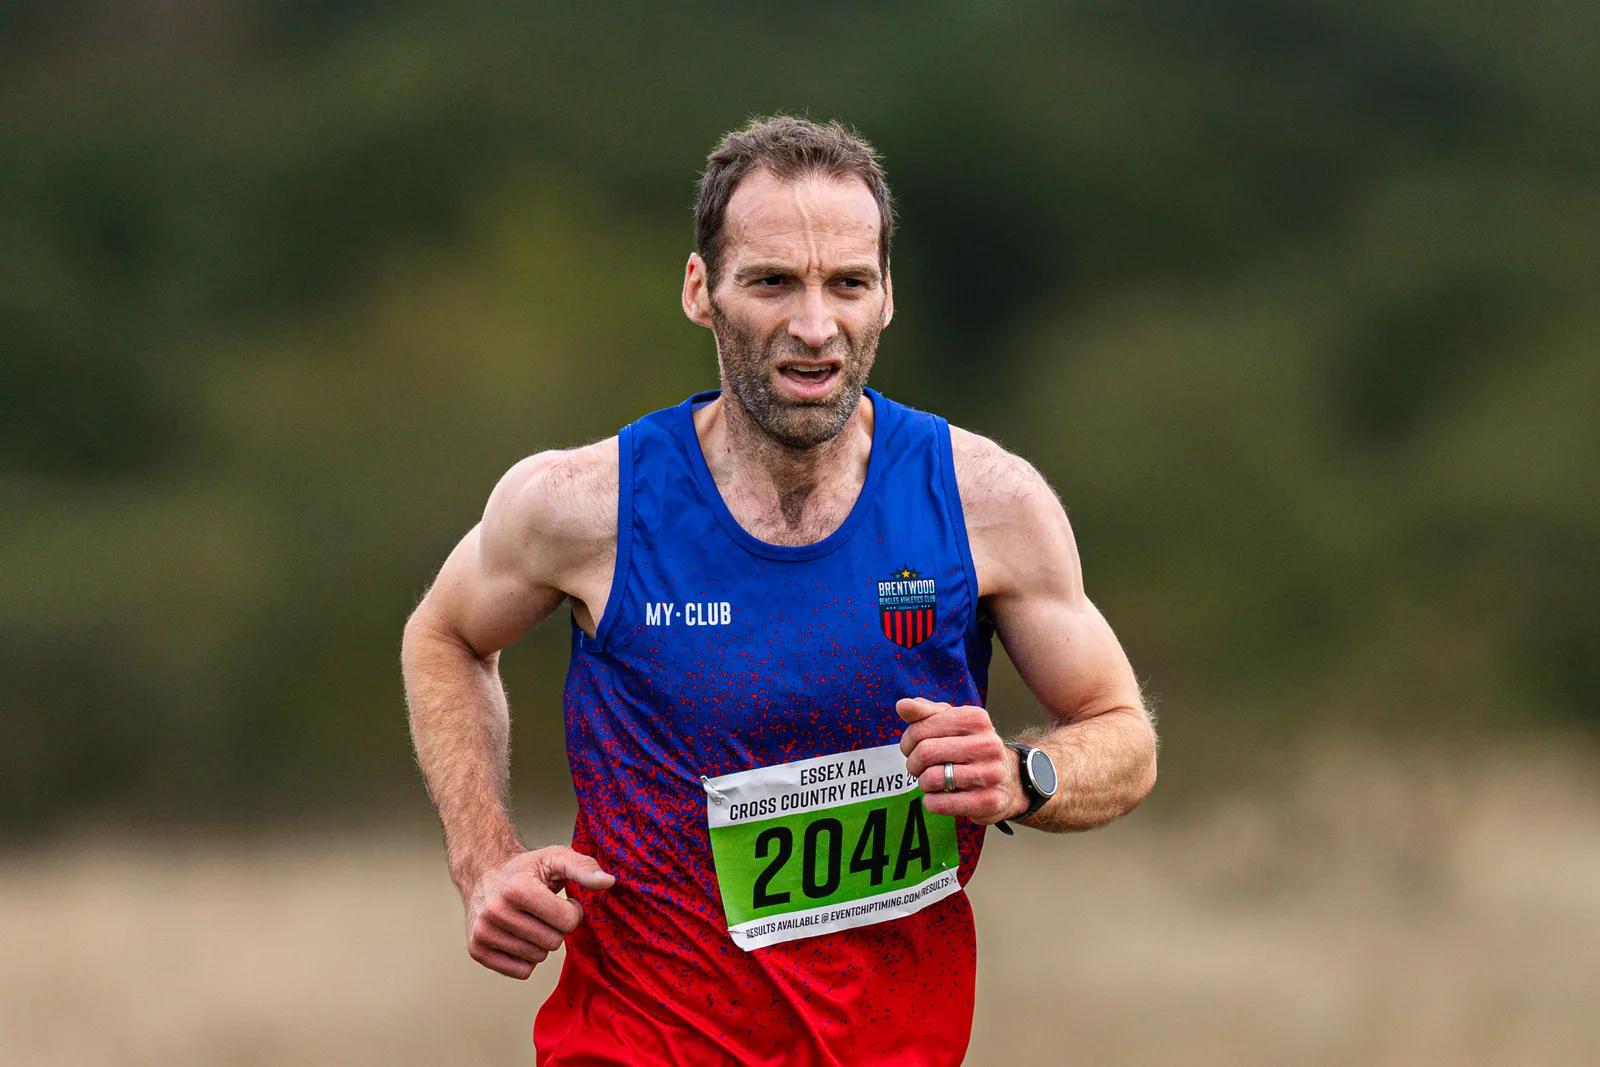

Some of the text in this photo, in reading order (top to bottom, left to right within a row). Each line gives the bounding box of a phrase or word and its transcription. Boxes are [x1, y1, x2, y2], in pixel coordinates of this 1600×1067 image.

[878, 579, 935, 596] BRENTWOOD
[900, 595, 923, 604] ATHLETICS
[924, 594, 936, 603] CLUB
[800, 759, 866, 786] ESSEX AA
[729, 797, 776, 821] CROSS
[781, 784, 846, 811] COUNTRY
[850, 775, 902, 798] RELAYS
[753, 795, 931, 910] 204A
[745, 922, 776, 940] RESULTS
[777, 914, 820, 932] AVAILABLE
[821, 912, 829, 924] @
